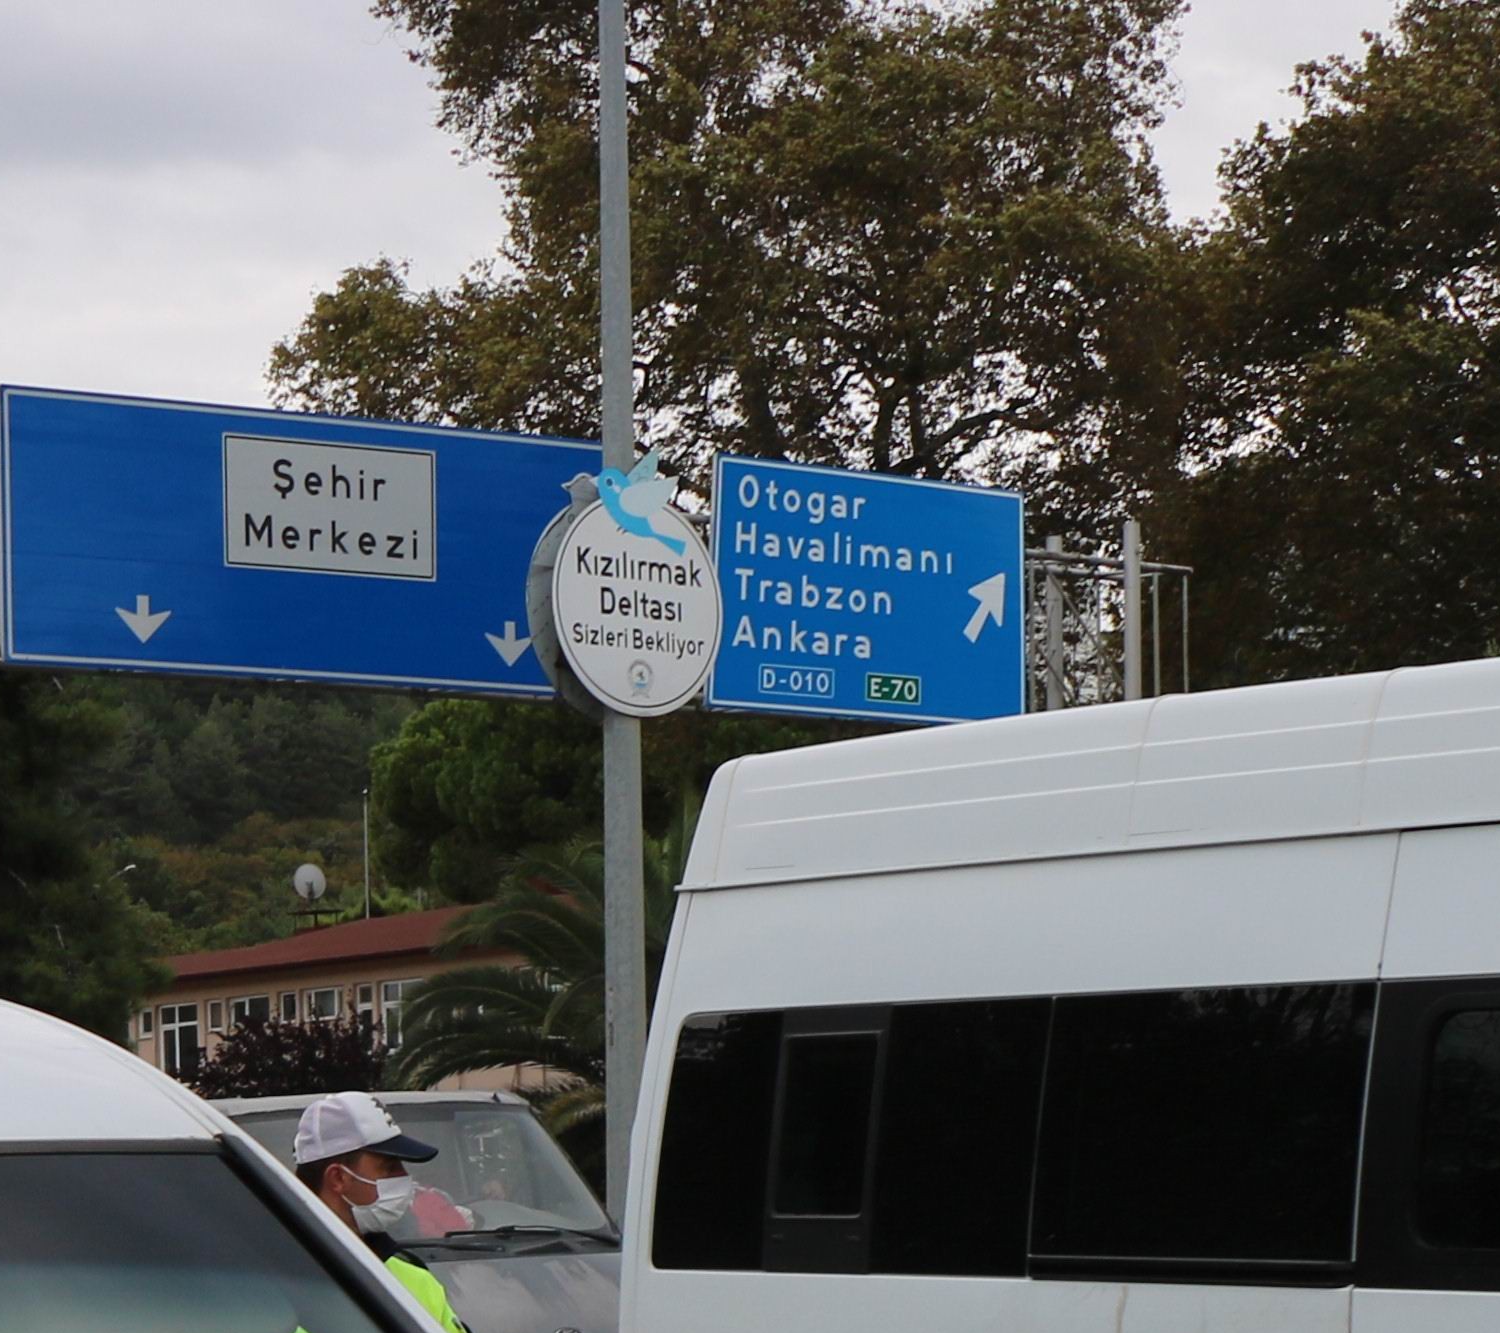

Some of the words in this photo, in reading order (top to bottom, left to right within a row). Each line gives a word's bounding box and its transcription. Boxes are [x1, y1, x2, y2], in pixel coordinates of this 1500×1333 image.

[272, 458, 387, 501] Şehir
[738, 474, 866, 524] Otogar
[244, 512, 419, 560] Merkezi
[735, 521, 953, 574] Havalimanı
[576, 545, 702, 588] Kızılırmak
[600, 587, 683, 622] Deltası
[734, 568, 892, 615] Trabzon
[572, 622, 629, 649] Sizleri
[632, 628, 705, 660] Bekliyor
[732, 615, 871, 659] Ankara
[762, 668, 829, 694] D-010
[870, 677, 917, 700] E-70
